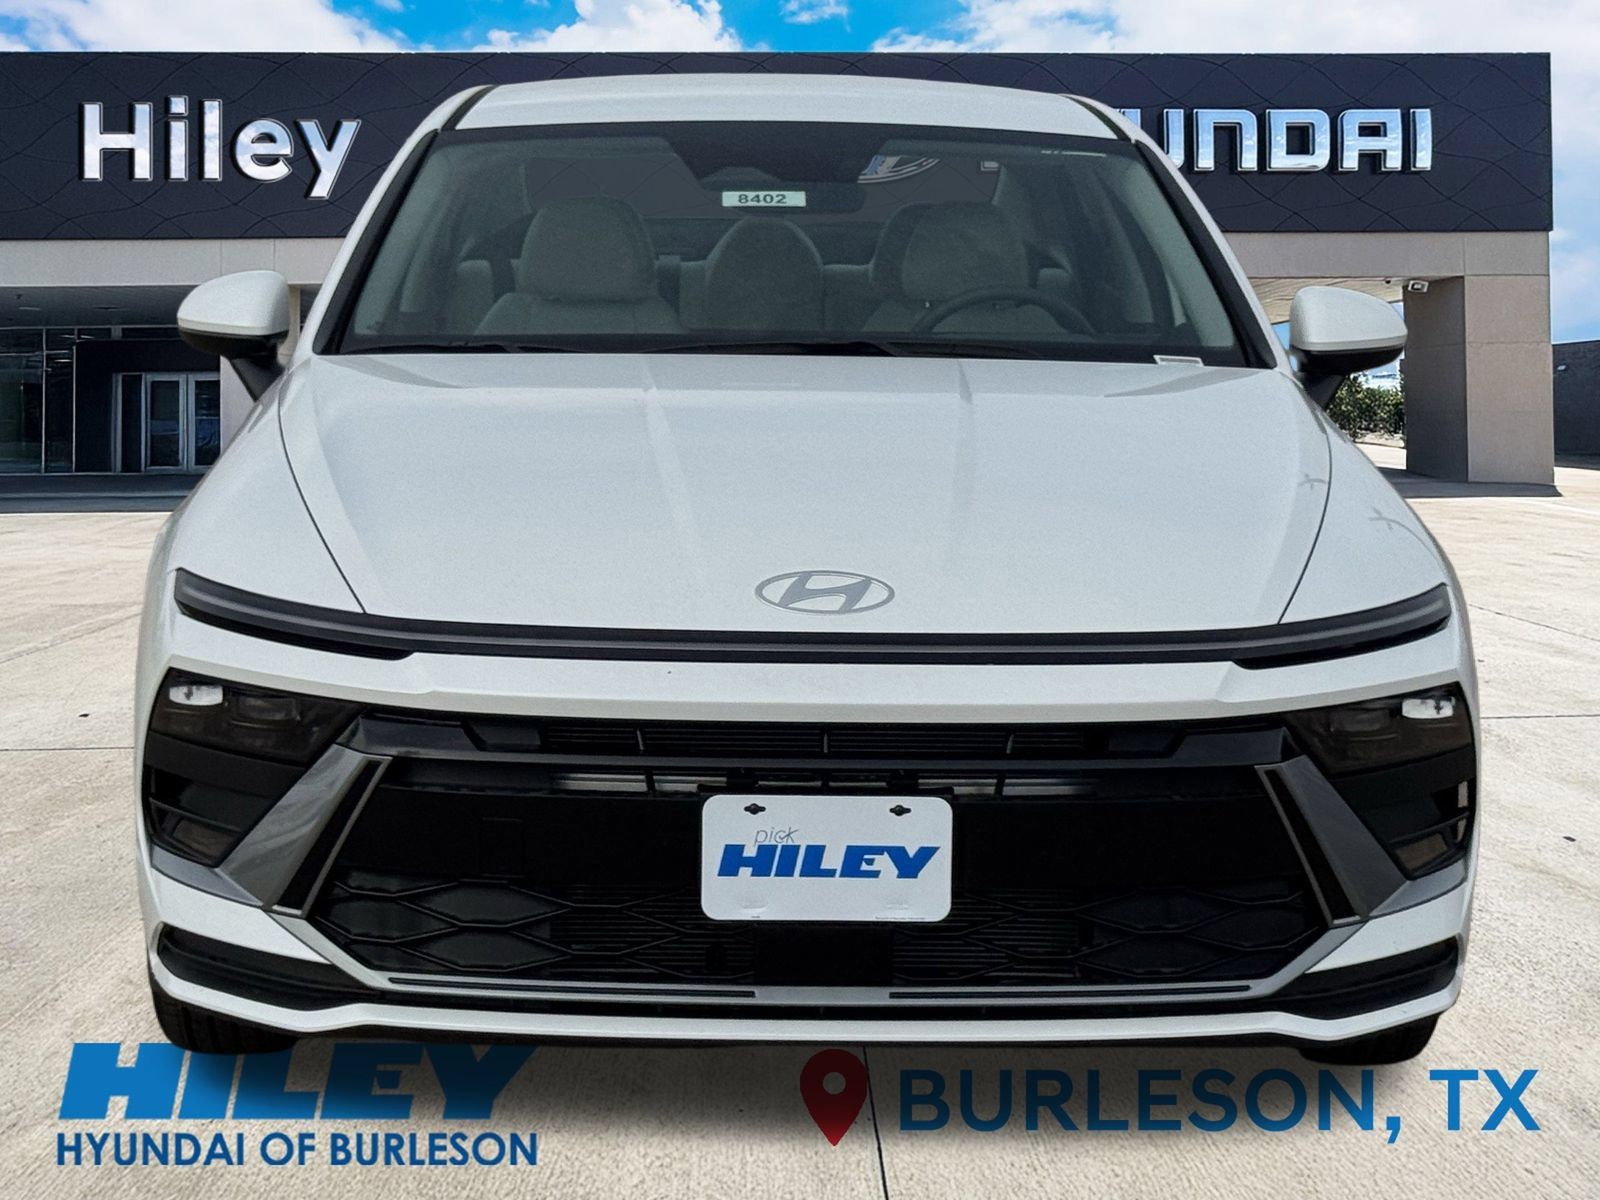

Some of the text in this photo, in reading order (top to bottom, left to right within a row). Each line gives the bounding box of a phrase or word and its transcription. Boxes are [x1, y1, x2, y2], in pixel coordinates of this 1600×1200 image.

[79, 95, 361, 199] Hiley
[1116, 108, 1433, 171] UNDAI
[738, 193, 787, 204] 8402
[717, 843, 941, 879] HILEY
